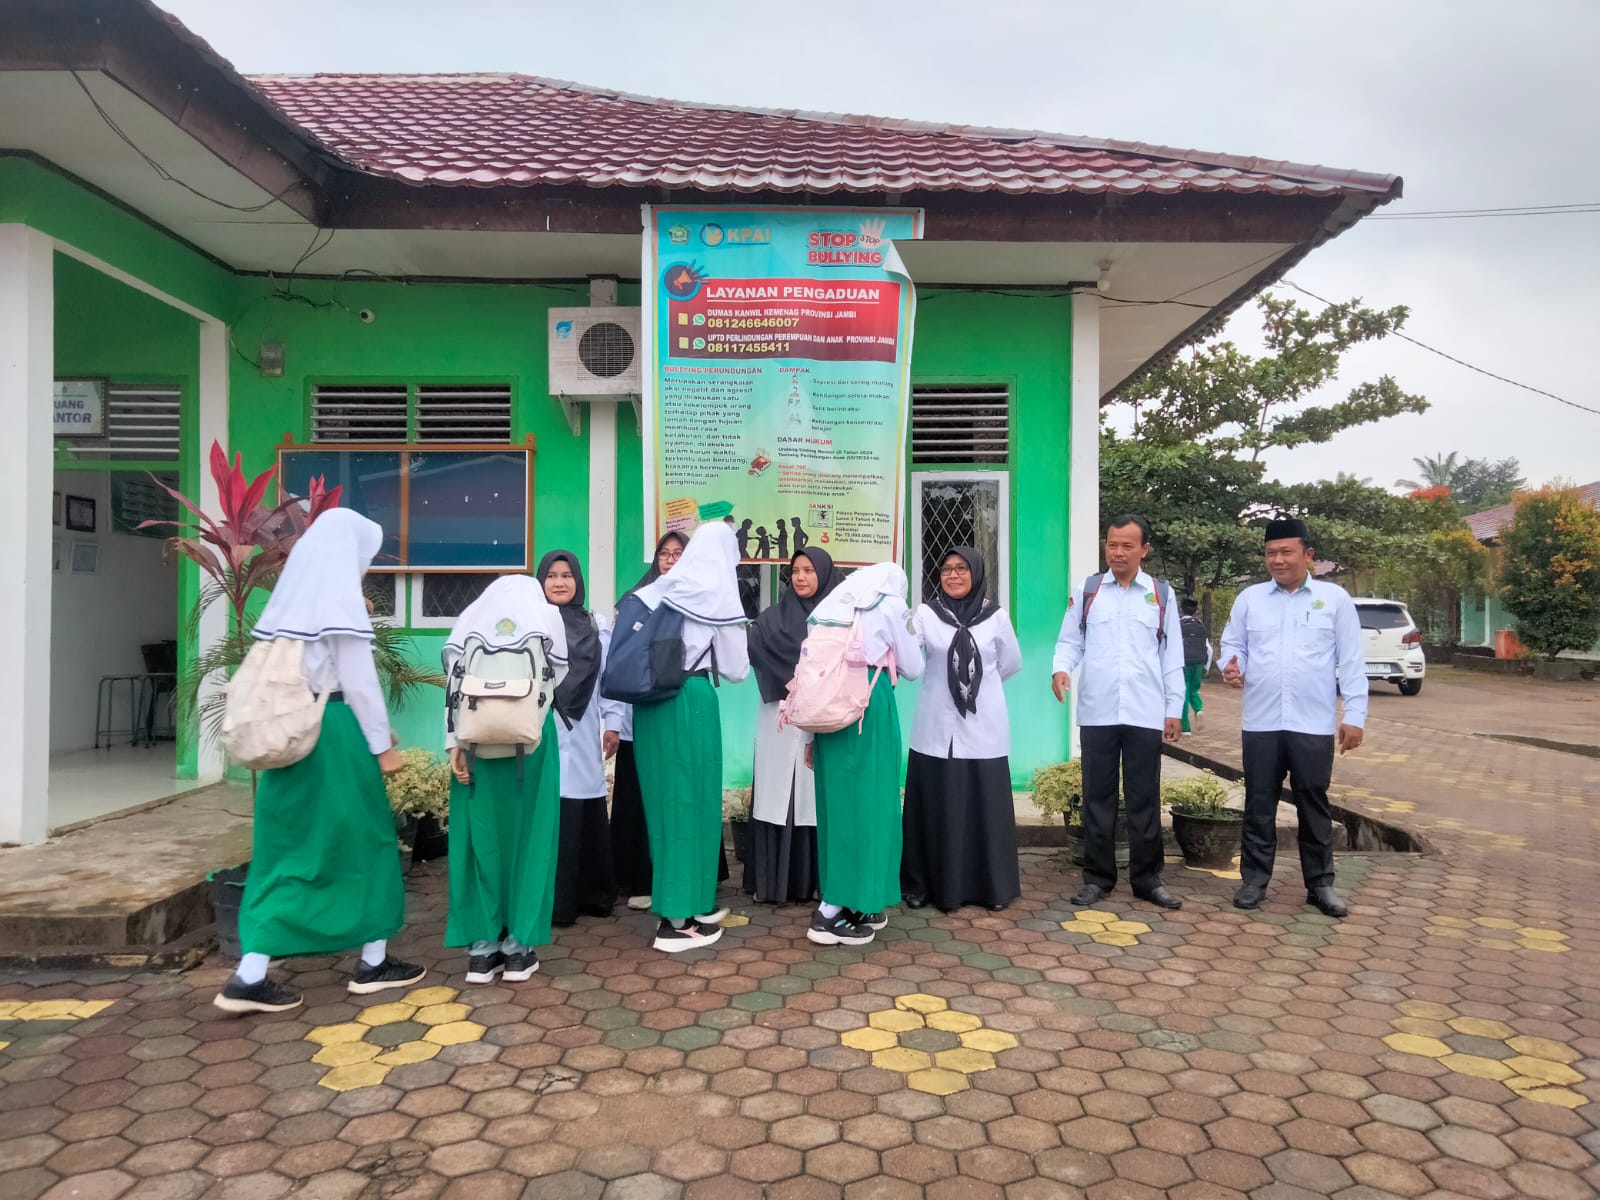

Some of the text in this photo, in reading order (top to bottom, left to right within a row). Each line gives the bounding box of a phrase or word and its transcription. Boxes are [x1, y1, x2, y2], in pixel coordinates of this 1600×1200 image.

[728, 228, 770, 242] KPAI
[809, 232, 857, 248] STOP
[808, 250, 882, 264] BULLYING
[706, 286, 879, 299] LAYANAN PENGADUAN
[707, 309, 733, 317] DUMAS
[764, 308, 799, 316] KEMENAG
[801, 308, 833, 318] PROVINSI
[835, 310, 857, 318] JAMBI
[707, 317, 800, 328] 081246646007
[707, 334, 725, 342] UPTD
[726, 334, 774, 342] PERLINDUNGAN
[775, 333, 812, 342] PEREMPUAN
[813, 335, 825, 343] DAN
[846, 335, 876, 343] PROVINSI
[877, 336, 894, 345] JAMBI
[707, 342, 790, 353] 08117455411
[665, 377, 706, 385] Merupakan
[54, 400, 85, 409] UANG
[54, 412, 92, 423] NTOR
